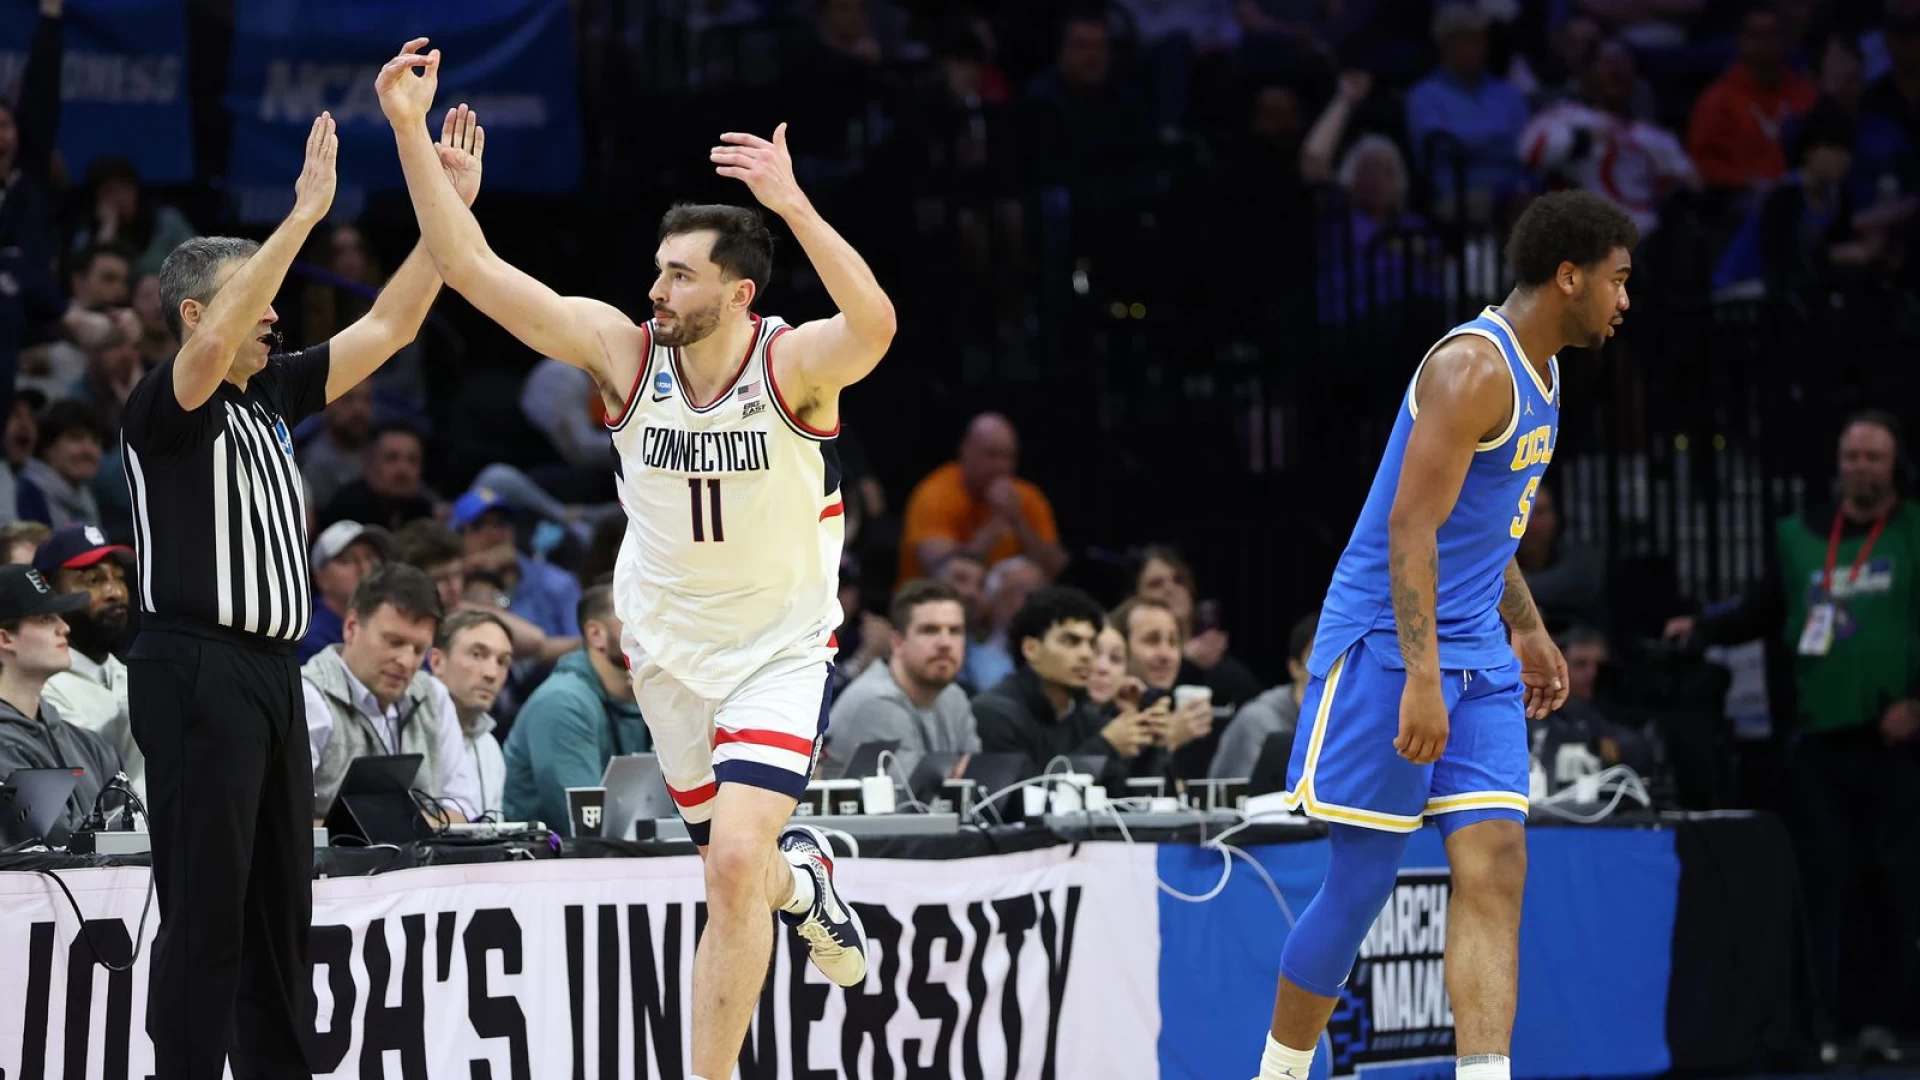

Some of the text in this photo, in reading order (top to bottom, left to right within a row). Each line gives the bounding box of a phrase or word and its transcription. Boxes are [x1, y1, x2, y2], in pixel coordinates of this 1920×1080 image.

[642, 426, 770, 472] CONNECTICUT
[1510, 424, 1558, 471] UCL
[687, 477, 725, 542] 11
[0, 907, 532, 1080] JOPH'S
[1371, 958, 1455, 1033] MADN
